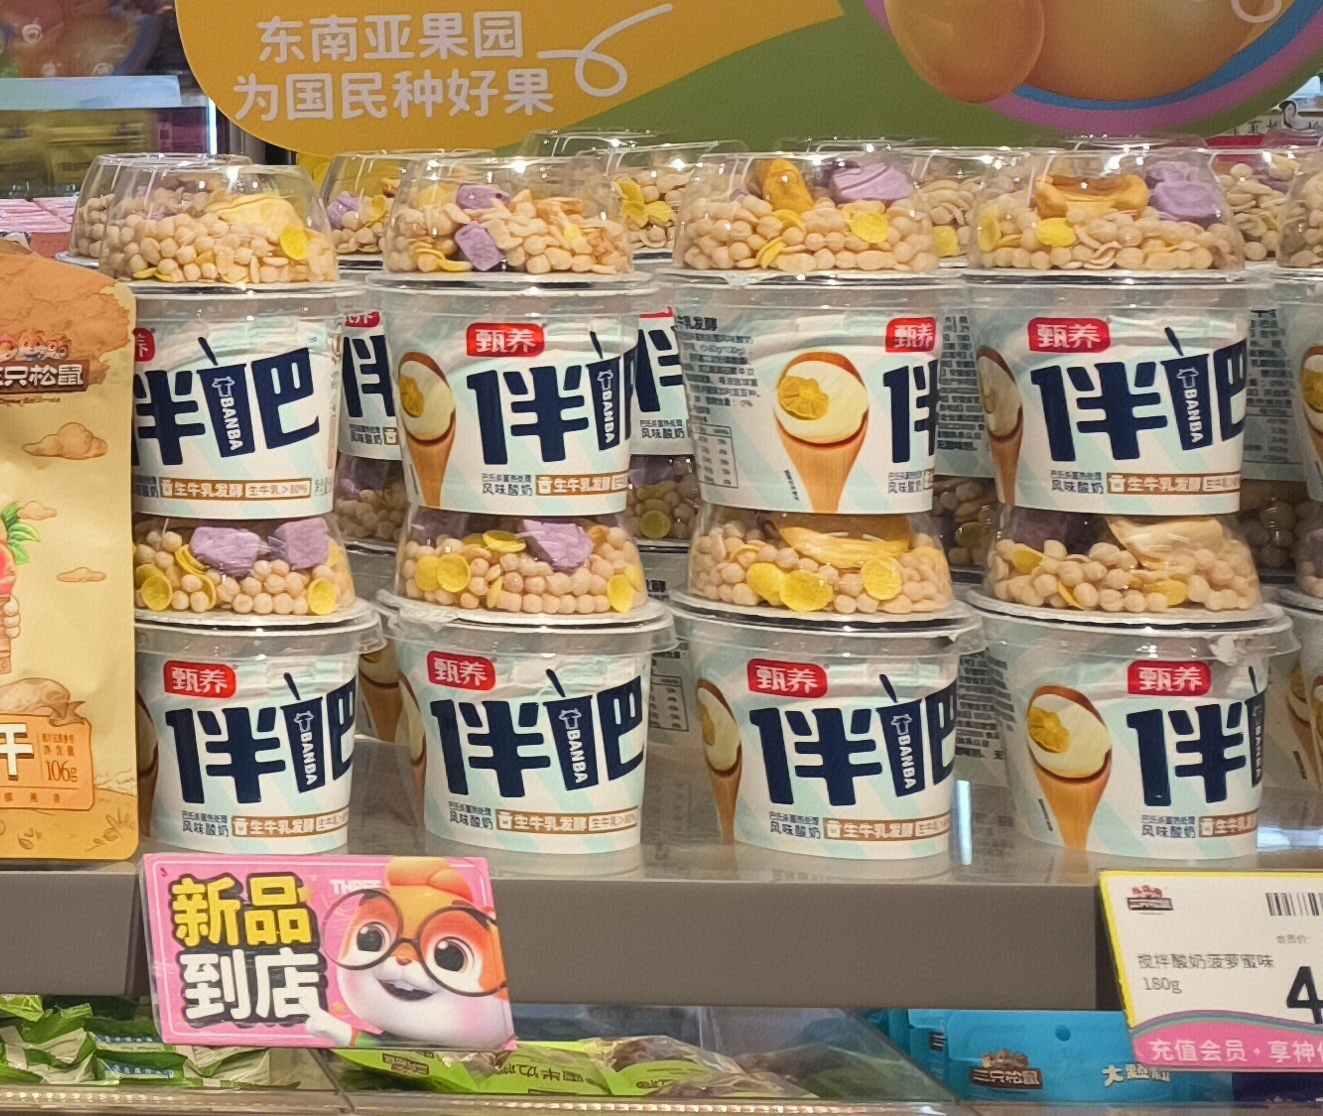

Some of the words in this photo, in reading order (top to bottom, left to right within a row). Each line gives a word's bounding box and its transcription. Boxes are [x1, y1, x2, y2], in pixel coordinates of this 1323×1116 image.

[255, 9, 525, 65] 东南亚果园
[233, 67, 555, 124] 为国民种好果
[474, 327, 538, 352] 甄养
[1036, 323, 1102, 349] 甄养
[219, 397, 244, 451] BANBA
[1184, 388, 1204, 443] BANBA
[171, 665, 229, 694] 甄养
[433, 656, 489, 686] 甄养
[755, 664, 818, 694] 甄养
[1138, 665, 1204, 693] 甄养
[300, 731, 318, 786] BANBA
[566, 728, 589, 783] BANBA
[897, 734, 917, 790] BANBA
[170, 874, 313, 947] 新品
[178, 946, 322, 1021] 到店
